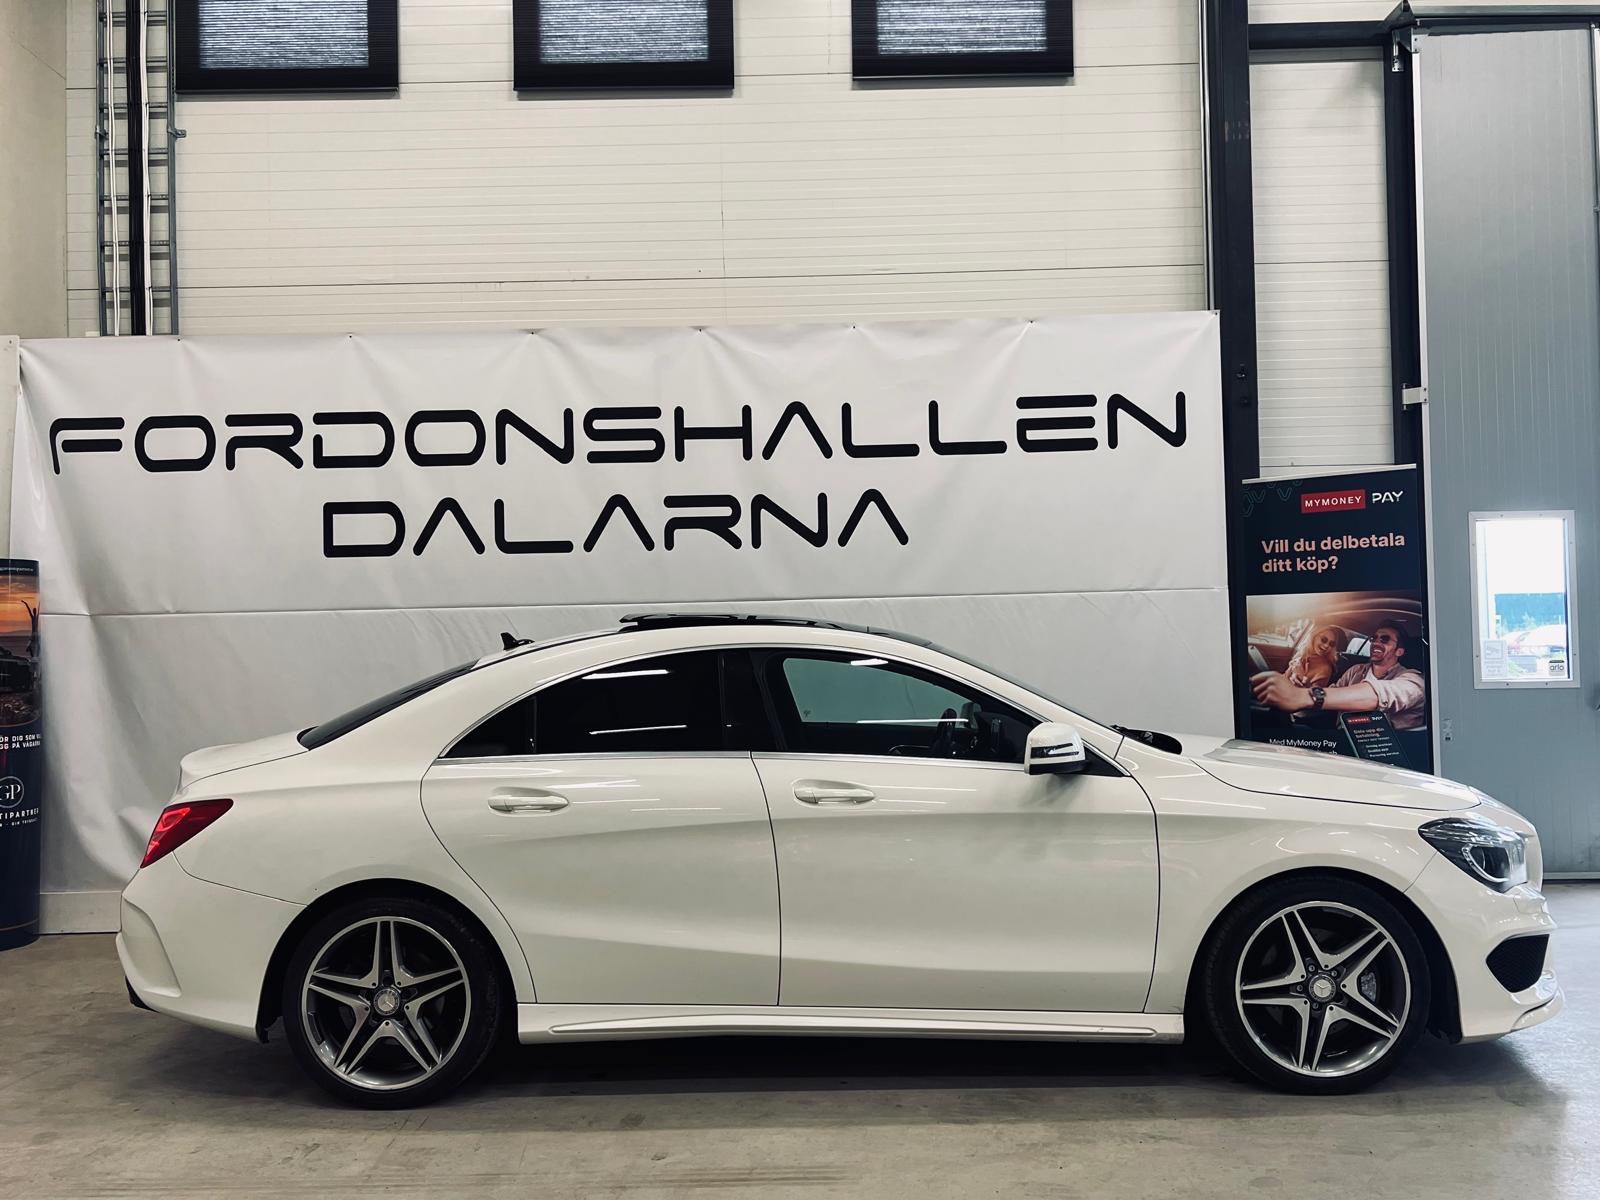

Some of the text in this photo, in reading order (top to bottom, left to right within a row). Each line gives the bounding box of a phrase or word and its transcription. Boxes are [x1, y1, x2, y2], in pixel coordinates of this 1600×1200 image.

[49, 391, 1187, 475] FORDONSHALLEN
[1305, 490, 1404, 507] MYMONEY PAY
[323, 488, 909, 558] DALARNA
[1261, 532, 1405, 554] Vill du delbetala
[1262, 555, 1338, 573] ditt köp?
[1286, 740, 1321, 748] MyMoney
[1323, 740, 1337, 748] Pay
